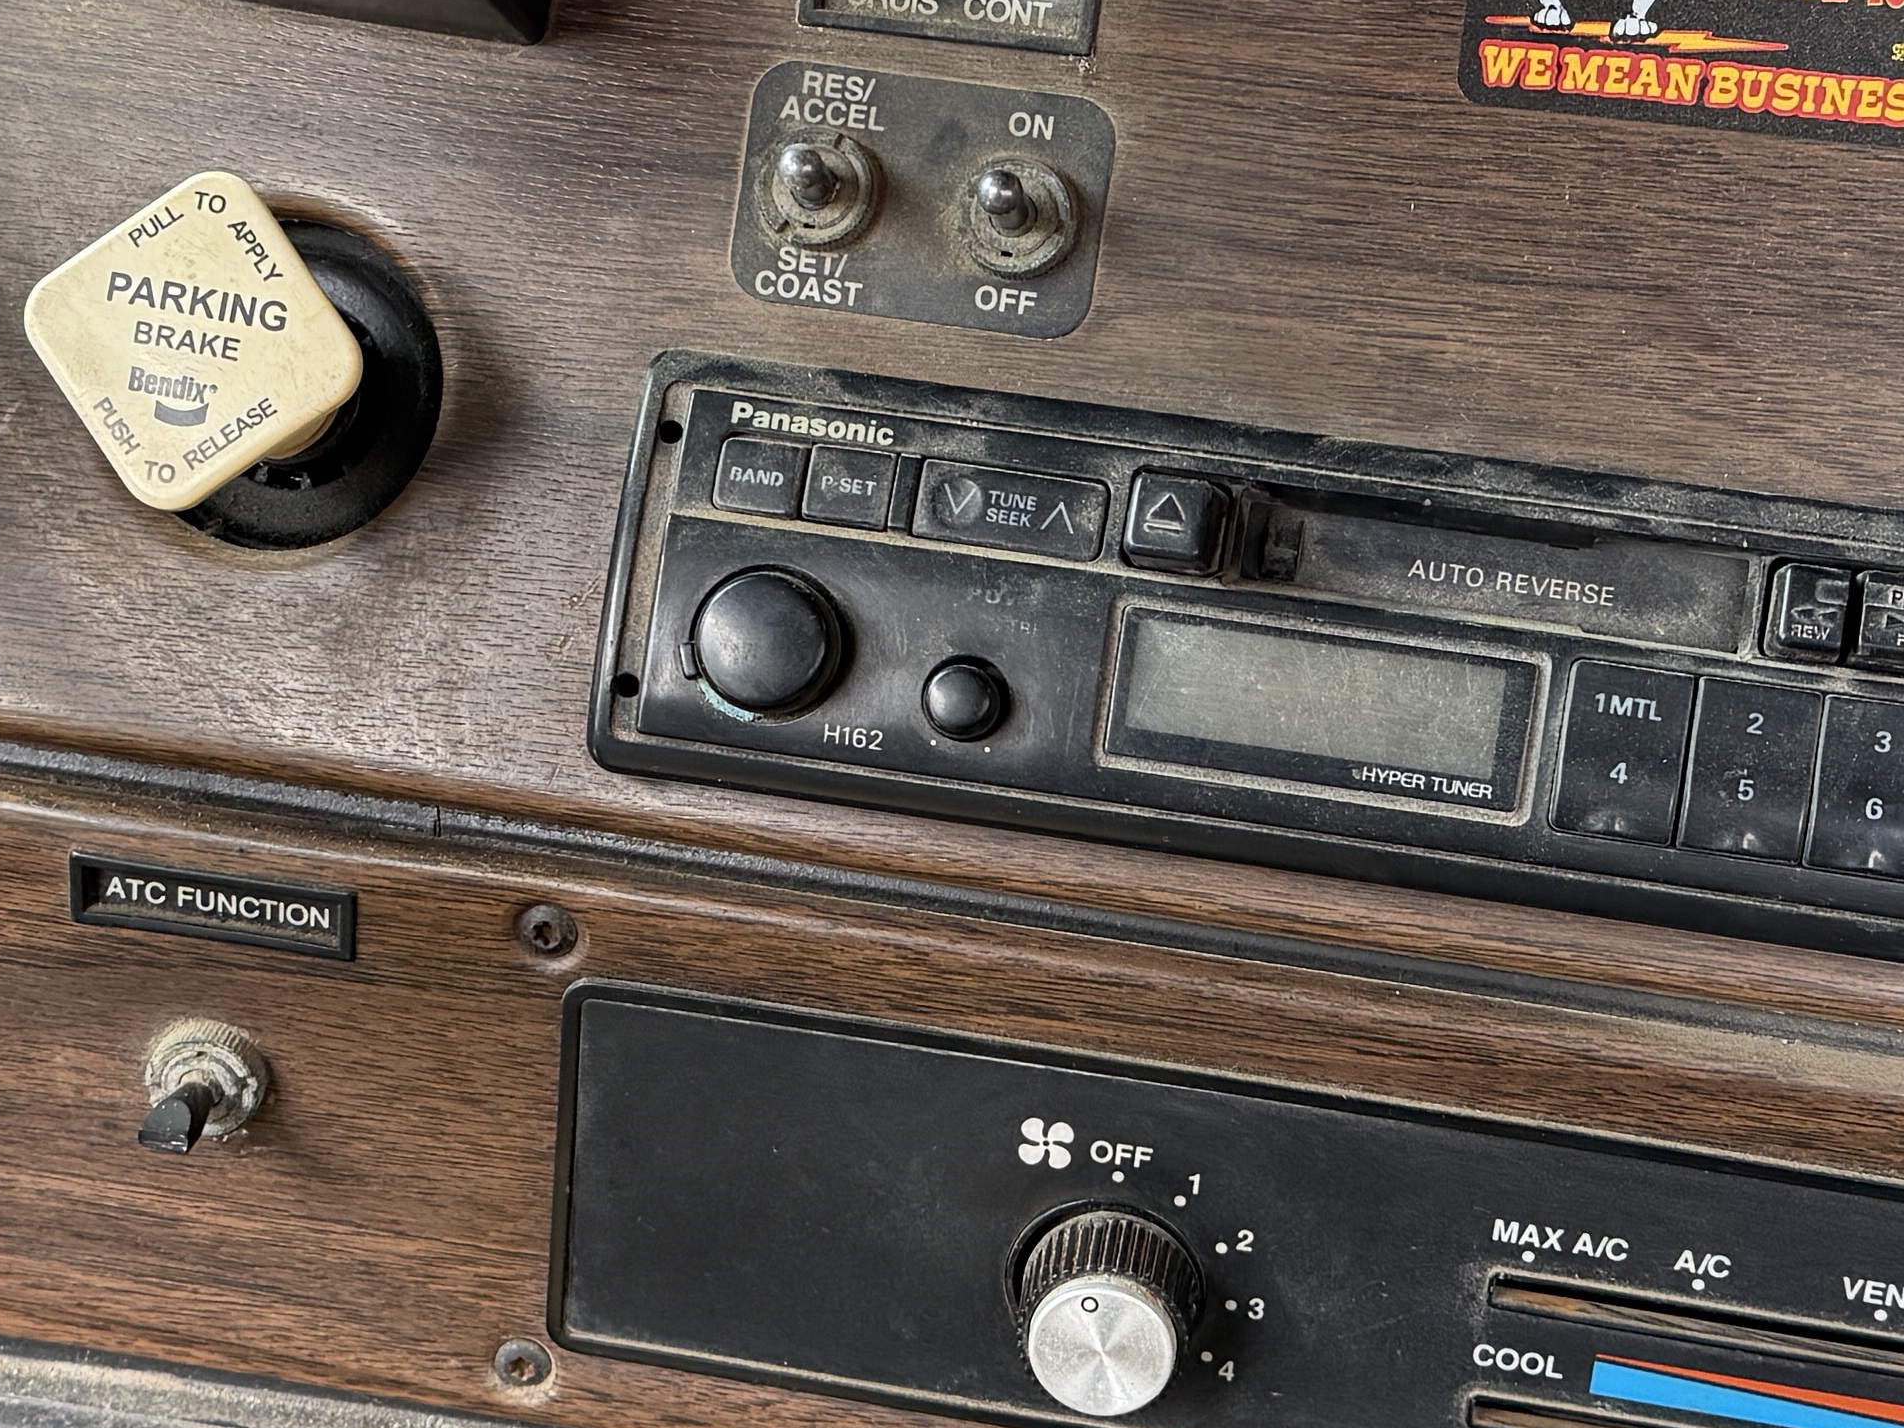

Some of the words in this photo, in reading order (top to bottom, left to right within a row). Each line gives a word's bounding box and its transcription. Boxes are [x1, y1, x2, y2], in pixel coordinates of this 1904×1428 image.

[801, 70, 877, 104] RES/
[1481, 42, 1554, 90] WE
[1559, 53, 1700, 106] MEAN
[778, 95, 886, 132] ACCEL
[1007, 111, 1056, 141] ON
[127, 204, 185, 249] PULL
[194, 190, 227, 215] TO
[226, 219, 284, 285] APPLY
[777, 246, 848, 276] SET/
[106, 270, 289, 333] PARKING
[754, 268, 864, 308] COAST
[974, 284, 1039, 316] OFF
[133, 320, 242, 362] BRAKE
[128, 366, 209, 404] Bendix
[92, 396, 142, 456] PUSH
[144, 459, 177, 485] TO
[182, 397, 279, 472] RELEASE
[731, 400, 896, 447] Panasonic
[728, 464, 785, 489] BAND
[985, 505, 1032, 529] SEEK
[987, 489, 1038, 513] TUNE
[1407, 558, 1486, 590] AUTO
[1494, 569, 1617, 608] REVERSE
[822, 724, 885, 752] H162
[1361, 767, 1426, 789] HYPER
[1431, 775, 1493, 800] TUNER
[103, 874, 168, 906] ATC
[176, 885, 333, 930] FUNCTION
[1089, 1139, 1155, 1169] OFF
[1235, 1228, 1256, 1253] 2
[1491, 1217, 1566, 1253] MAX
[1571, 1230, 1630, 1263] A/C
[1672, 1248, 1733, 1280] A/C
[1246, 1297, 1265, 1321] 3
[1217, 1360, 1236, 1382] 4
[1471, 1343, 1564, 1380] COOL
